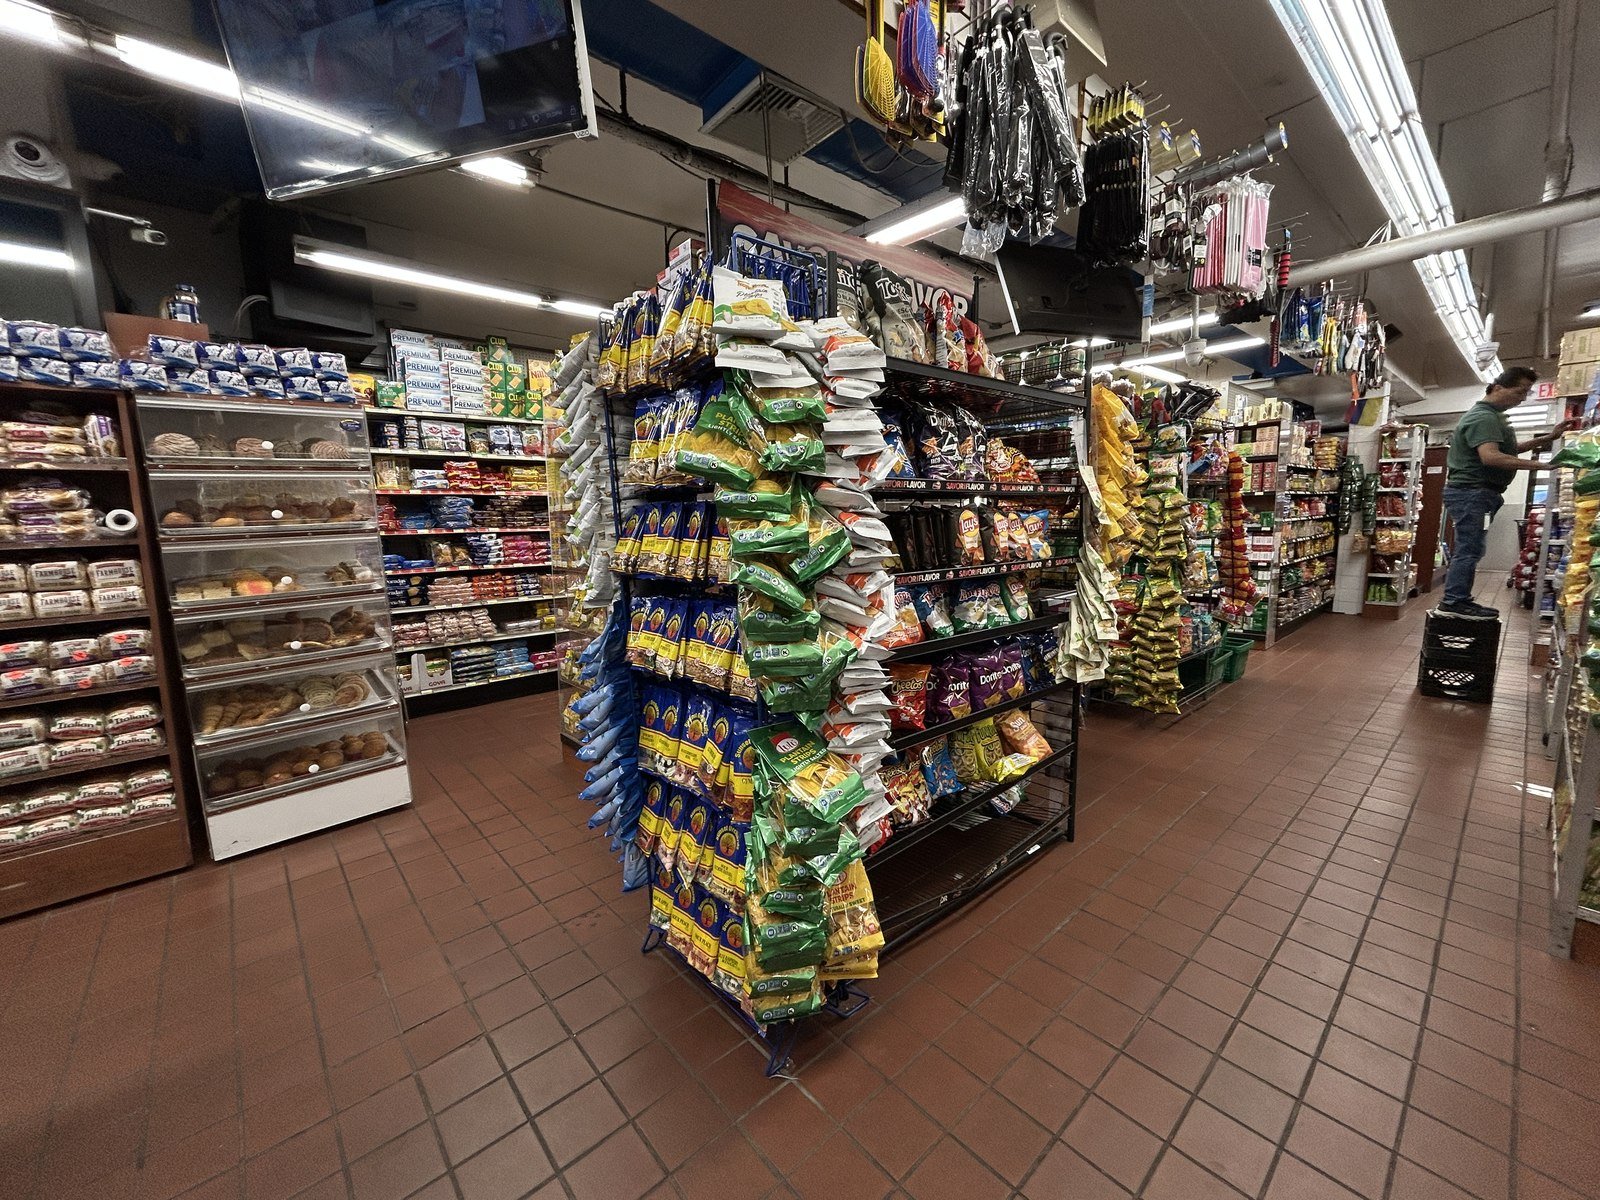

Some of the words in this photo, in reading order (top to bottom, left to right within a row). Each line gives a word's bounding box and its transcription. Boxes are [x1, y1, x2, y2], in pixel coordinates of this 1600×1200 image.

[392, 334, 426, 344] PREMIUM
[490, 336, 506, 346] CLUB
[396, 350, 430, 359] PREMIUM
[406, 362, 440, 372] PREMIUM
[450, 366, 482, 376] PREMIUM
[488, 362, 504, 371] CLUB
[506, 364, 522, 374] CLUB
[406, 380, 440, 390] PREMIUM
[452, 384, 483, 392] PREMIUM
[490, 391, 506, 400] CLUB
[526, 391, 542, 400] CLUB
[408, 398, 442, 406] PREMIUM
[708, 424, 733, 436] LIGHTLY
[903, 481, 926, 489] FLAVOR
[961, 518, 979, 534] Lay's
[35, 568, 76, 578] FARMHOUSE
[96, 566, 134, 577] FARMHOUSE
[976, 566, 996, 576] FLAVOR
[896, 576, 917, 584] SAVOR
[918, 572, 940, 582] FLAVOR
[40, 595, 80, 606] FARMHOUSE
[99, 592, 136, 602] FARMHOUSE
[892, 678, 924, 696] Cheetos
[114, 712, 149, 724] Italian
[58, 721, 94, 729] Italian
[1010, 718, 1026, 732] Sun
[116, 736, 150, 746] Italian
[58, 746, 94, 757] Italian
[780, 740, 816, 764] PLANTAIN
[790, 748, 817, 764] STRIPS
[792, 760, 810, 772] LIGHTLY
[134, 777, 166, 790] Italian
[82, 790, 118, 798] Italian
[26, 798, 65, 810] Italian
[137, 802, 170, 812] Italian
[86, 810, 120, 820] Italian
[30, 826, 68, 838] Italian
